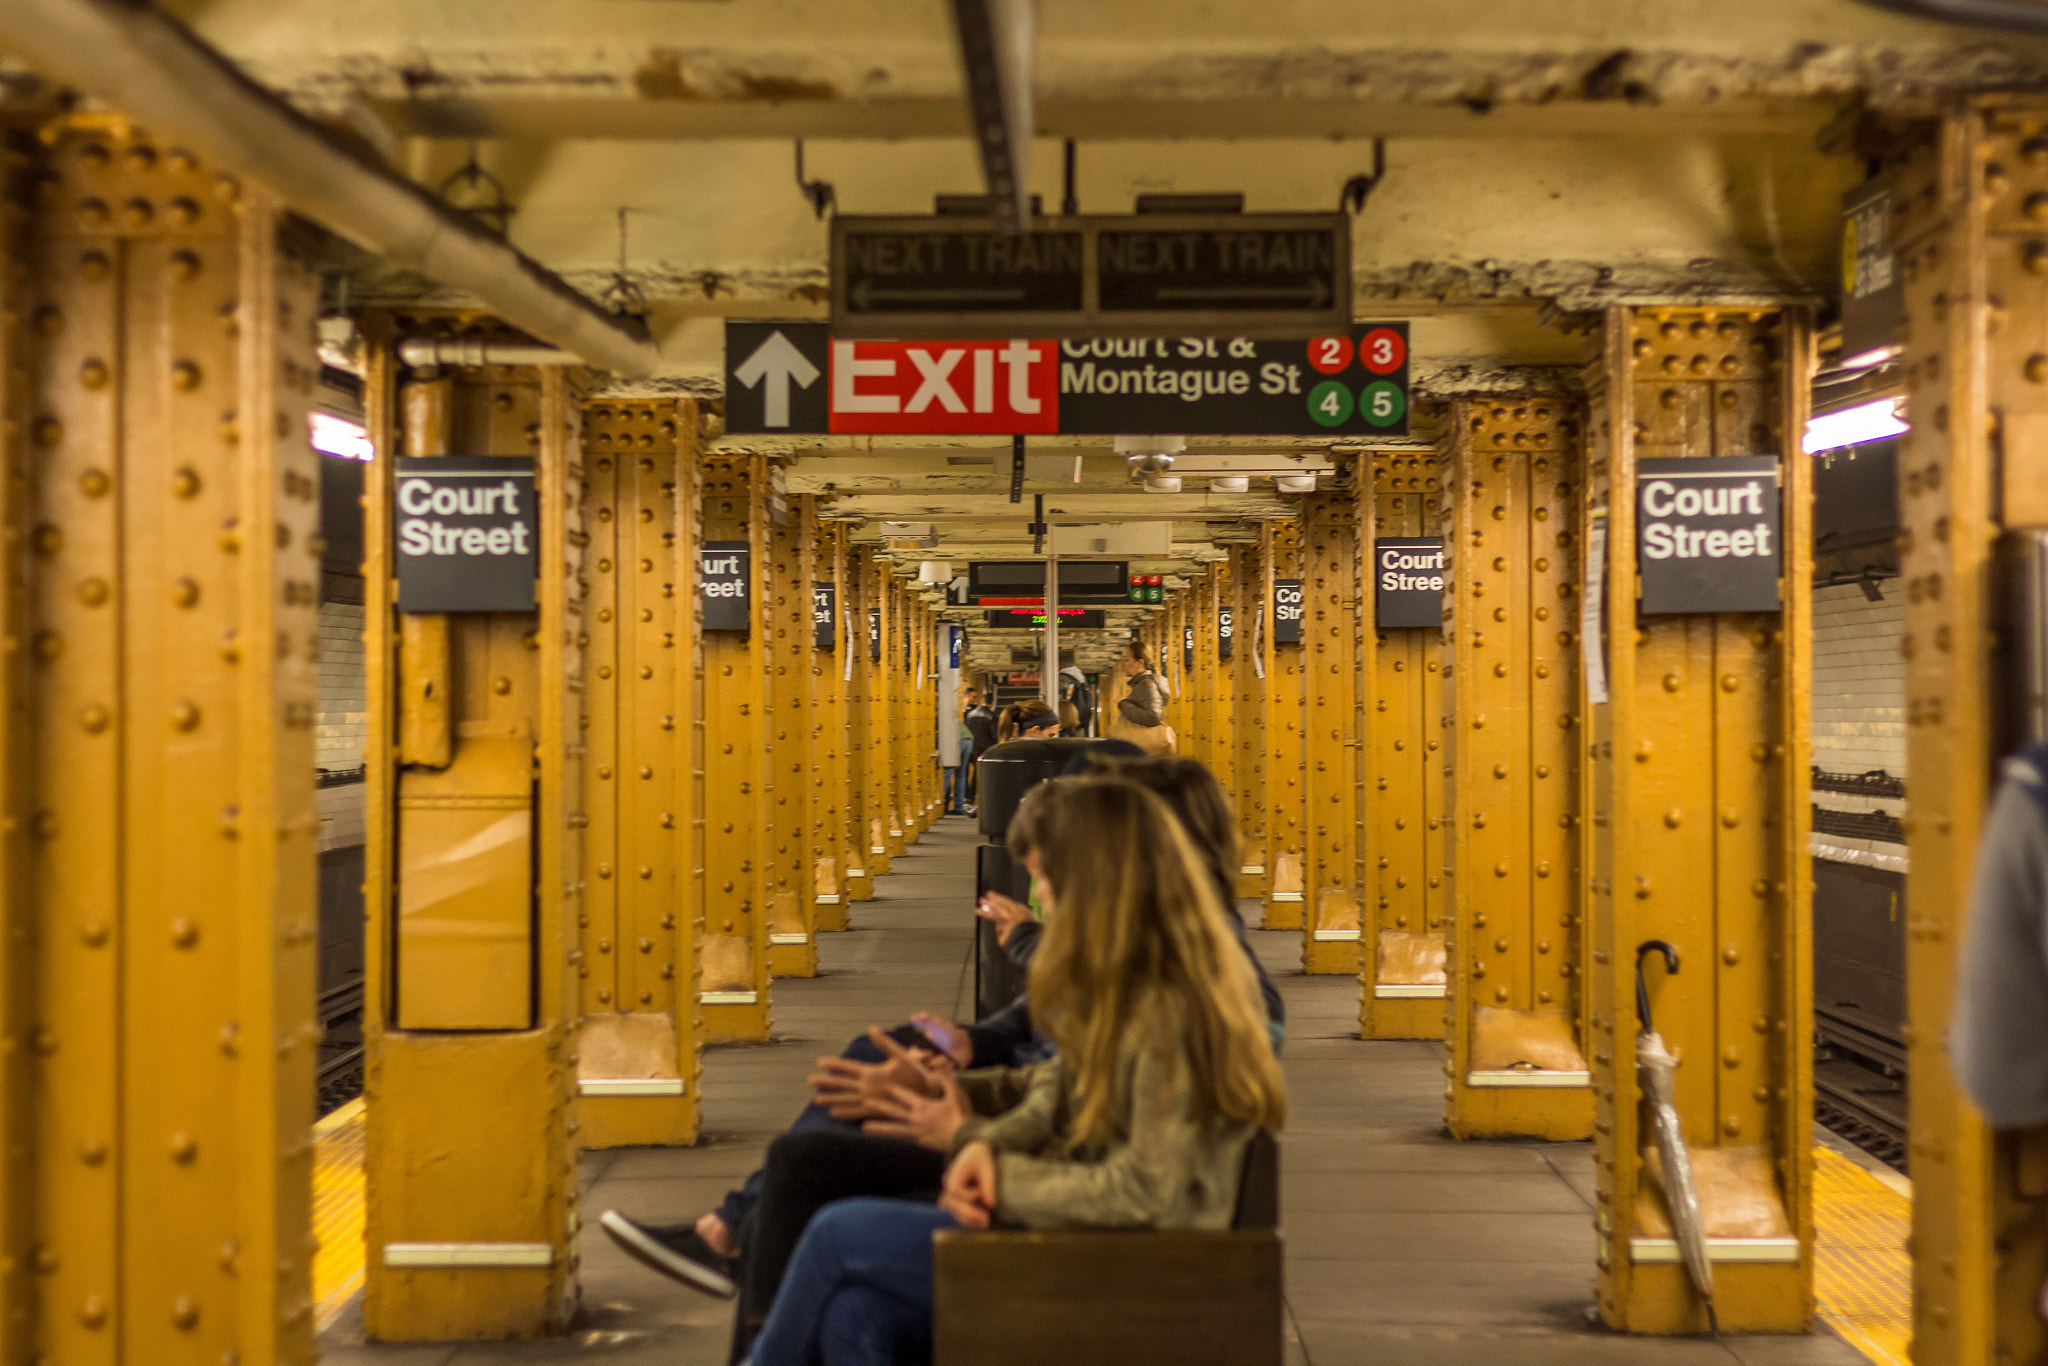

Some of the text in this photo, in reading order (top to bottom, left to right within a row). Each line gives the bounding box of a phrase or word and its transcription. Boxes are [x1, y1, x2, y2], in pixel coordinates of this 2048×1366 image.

[850, 235, 1081, 273] NEXT TRAIN
[1104, 235, 1335, 273] NEXT TRAIN
[1320, 338, 1394, 365] 2 3
[833, 339, 1041, 414] Exit
[1060, 361, 1302, 402] Montague St
[1320, 390, 1393, 417] 4 5
[400, 478, 520, 516] Court
[1643, 480, 1763, 518] Court
[400, 518, 530, 556] Street
[1643, 522, 1771, 560] Street
[703, 555, 740, 575] urt
[1381, 550, 1445, 570] Court
[1381, 571, 1445, 591] Stree
